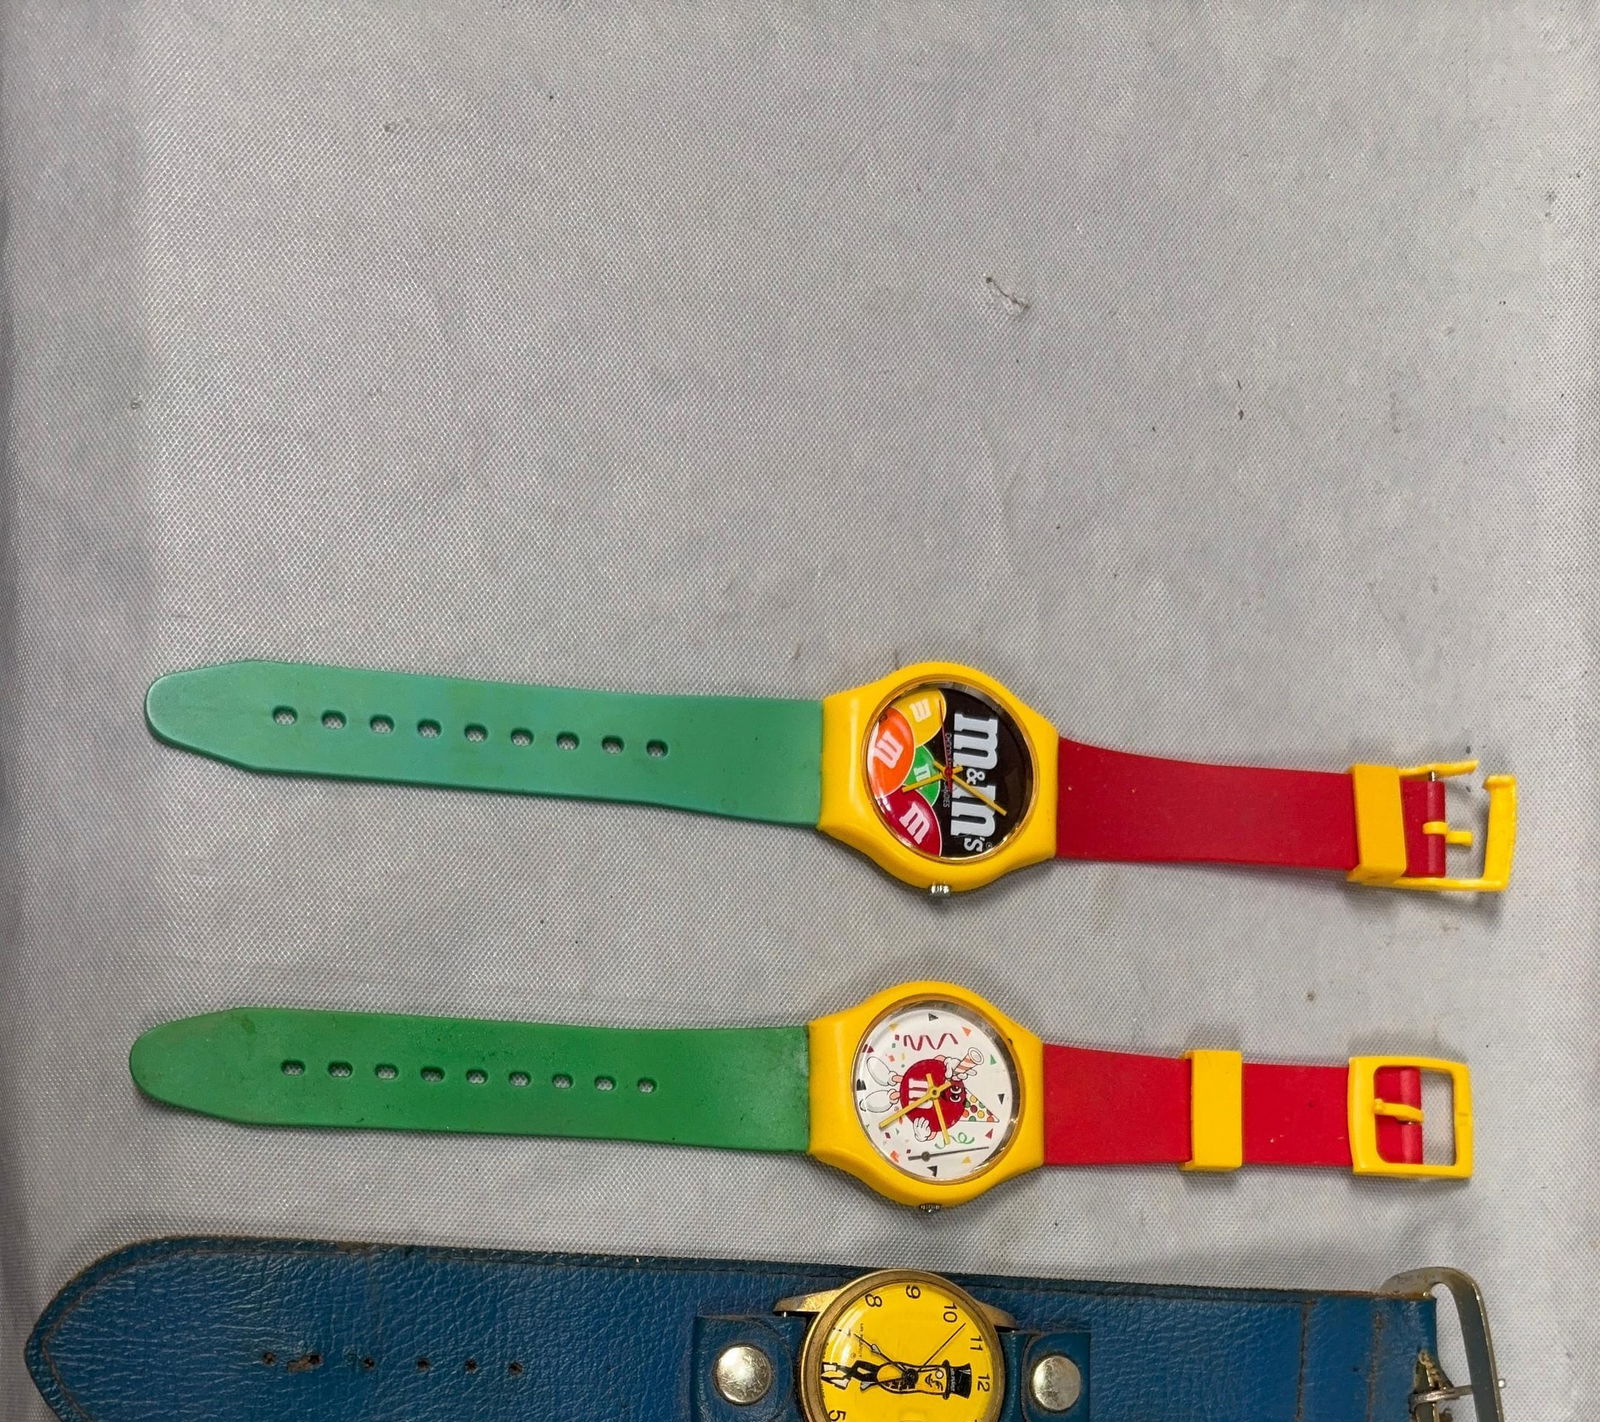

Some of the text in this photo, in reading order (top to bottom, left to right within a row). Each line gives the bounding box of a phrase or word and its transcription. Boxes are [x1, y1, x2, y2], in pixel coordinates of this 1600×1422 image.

[905, 1285, 921, 1299] 9
[865, 1294, 882, 1308] 8
[943, 1303, 956, 1323] 10
[970, 1335, 983, 1351] 11
[977, 1374, 990, 1392] 12
[829, 1409, 846, 1422] 5
